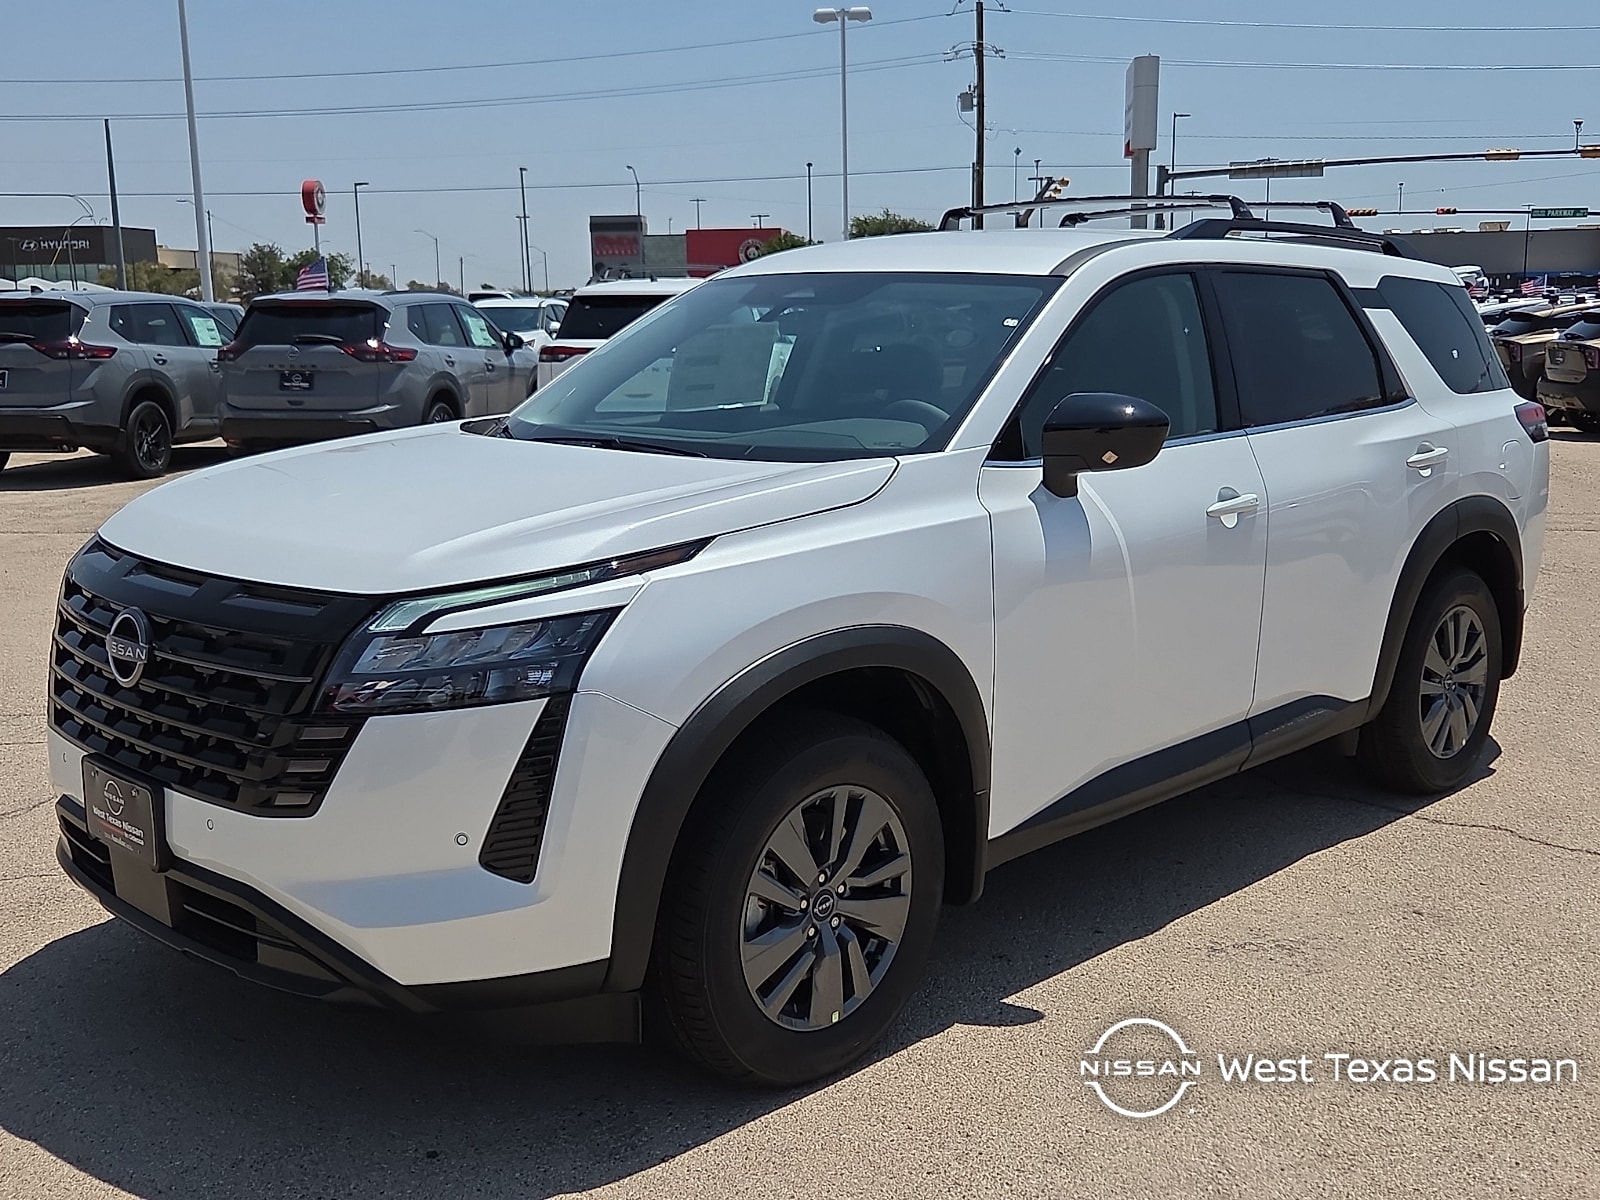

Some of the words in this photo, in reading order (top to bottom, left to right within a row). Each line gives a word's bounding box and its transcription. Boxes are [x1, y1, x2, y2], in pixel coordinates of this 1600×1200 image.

[1547, 209, 1575, 217] PARKWAY
[40, 239, 90, 250] HYUNDAI
[106, 812, 122, 828] Texas
[122, 820, 144, 838] Nissan
